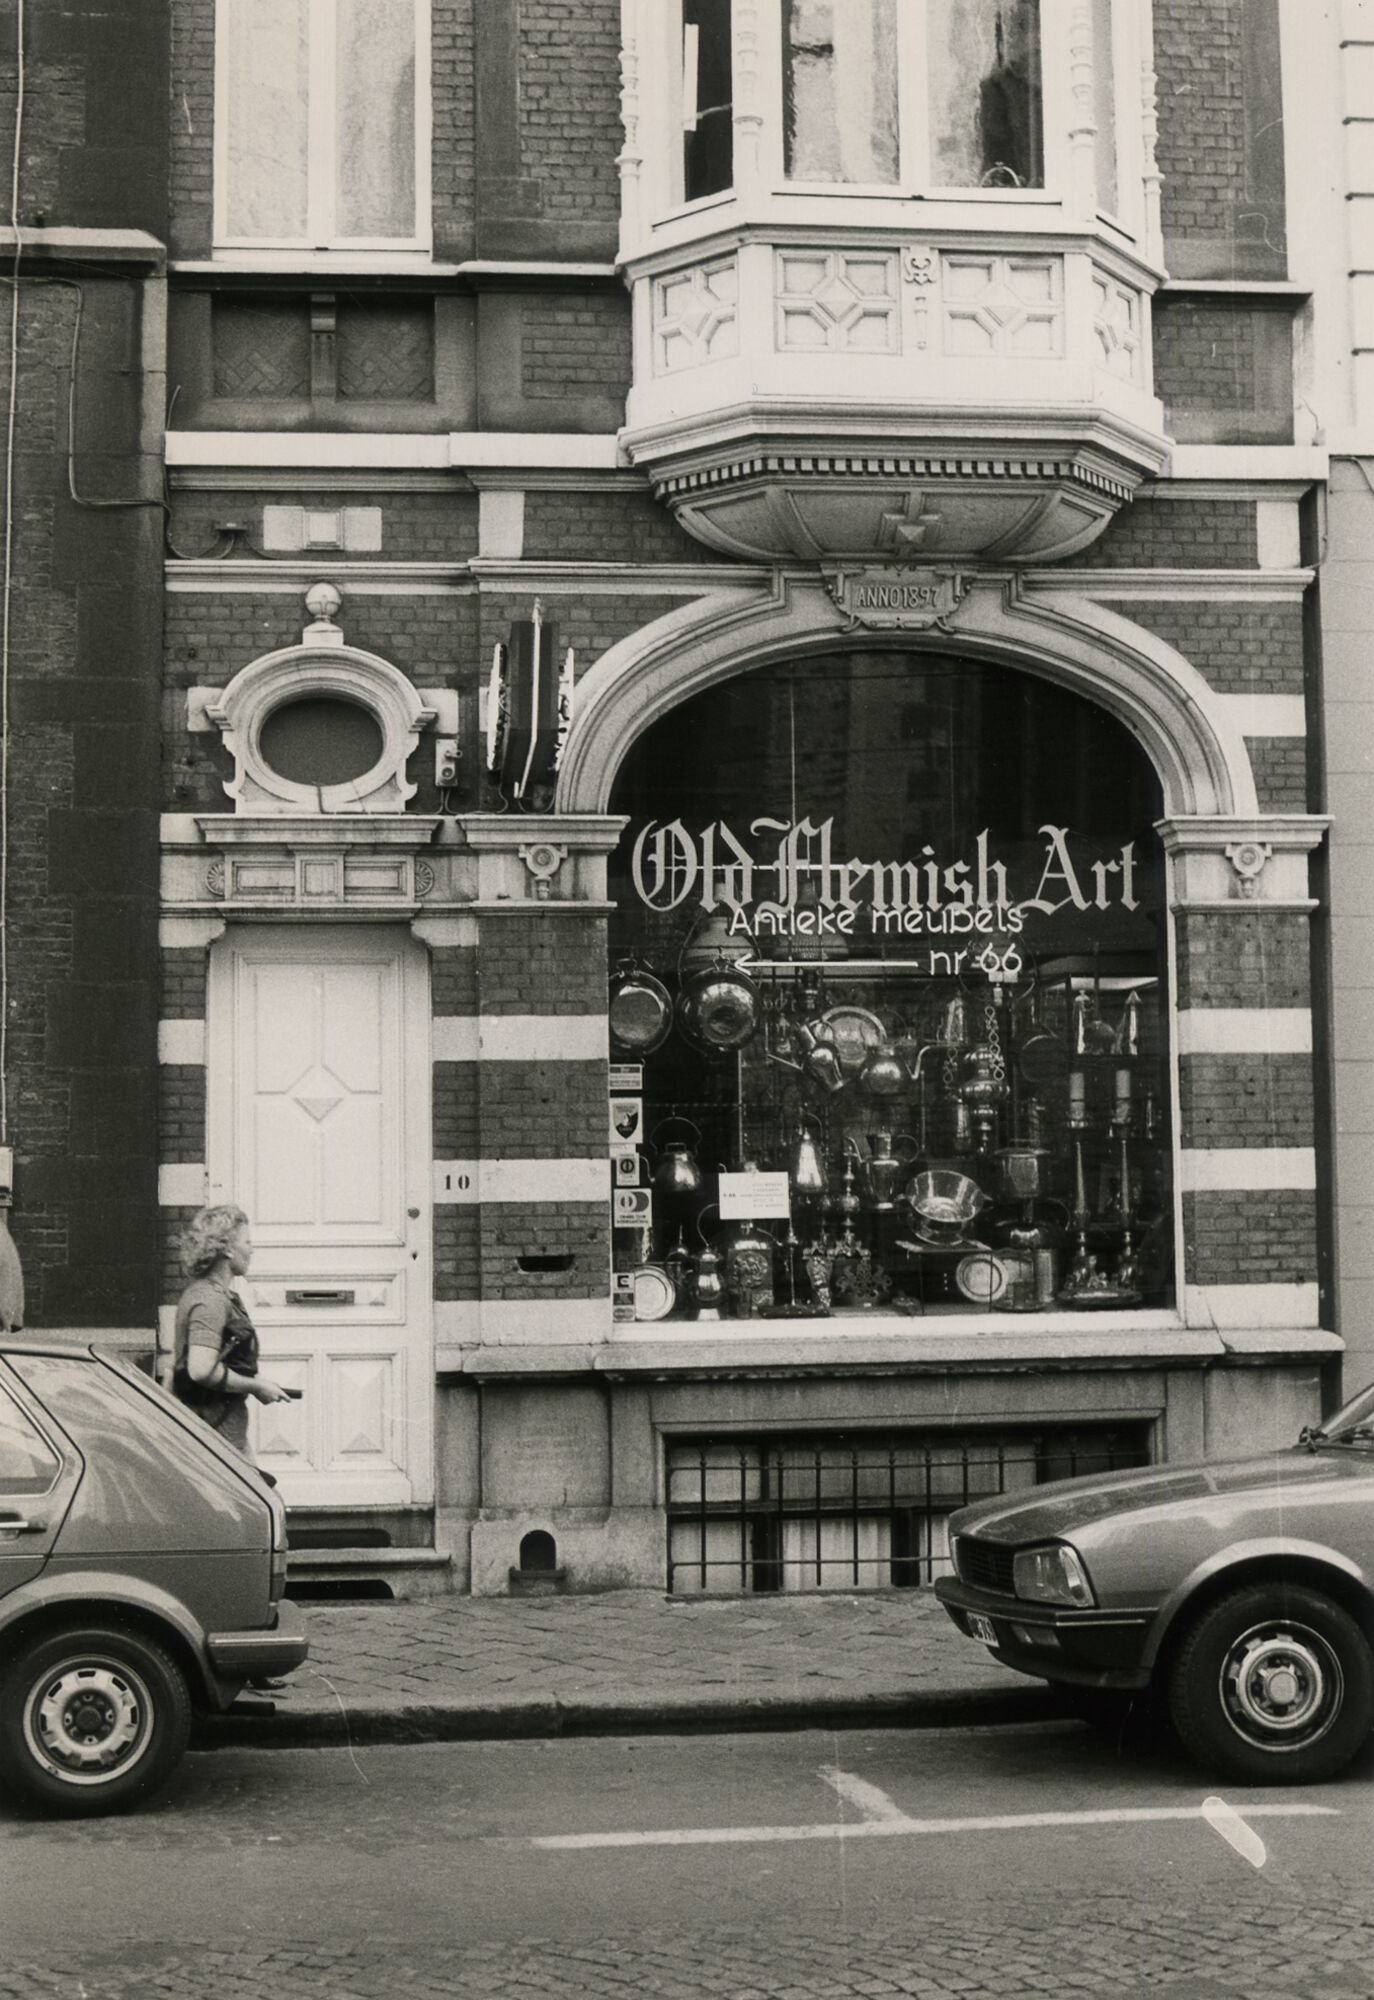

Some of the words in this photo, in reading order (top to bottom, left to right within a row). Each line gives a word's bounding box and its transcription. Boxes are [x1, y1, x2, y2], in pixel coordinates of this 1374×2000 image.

[632, 817, 754, 912] Old
[750, 816, 1012, 916] Flemish
[1014, 825, 1141, 917] Art
[729, 905, 857, 937] Antieke
[871, 903, 1024, 934] meubels
[929, 949, 968, 976] nr
[979, 942, 1023, 974] 66
[445, 1174, 471, 1191] 10
